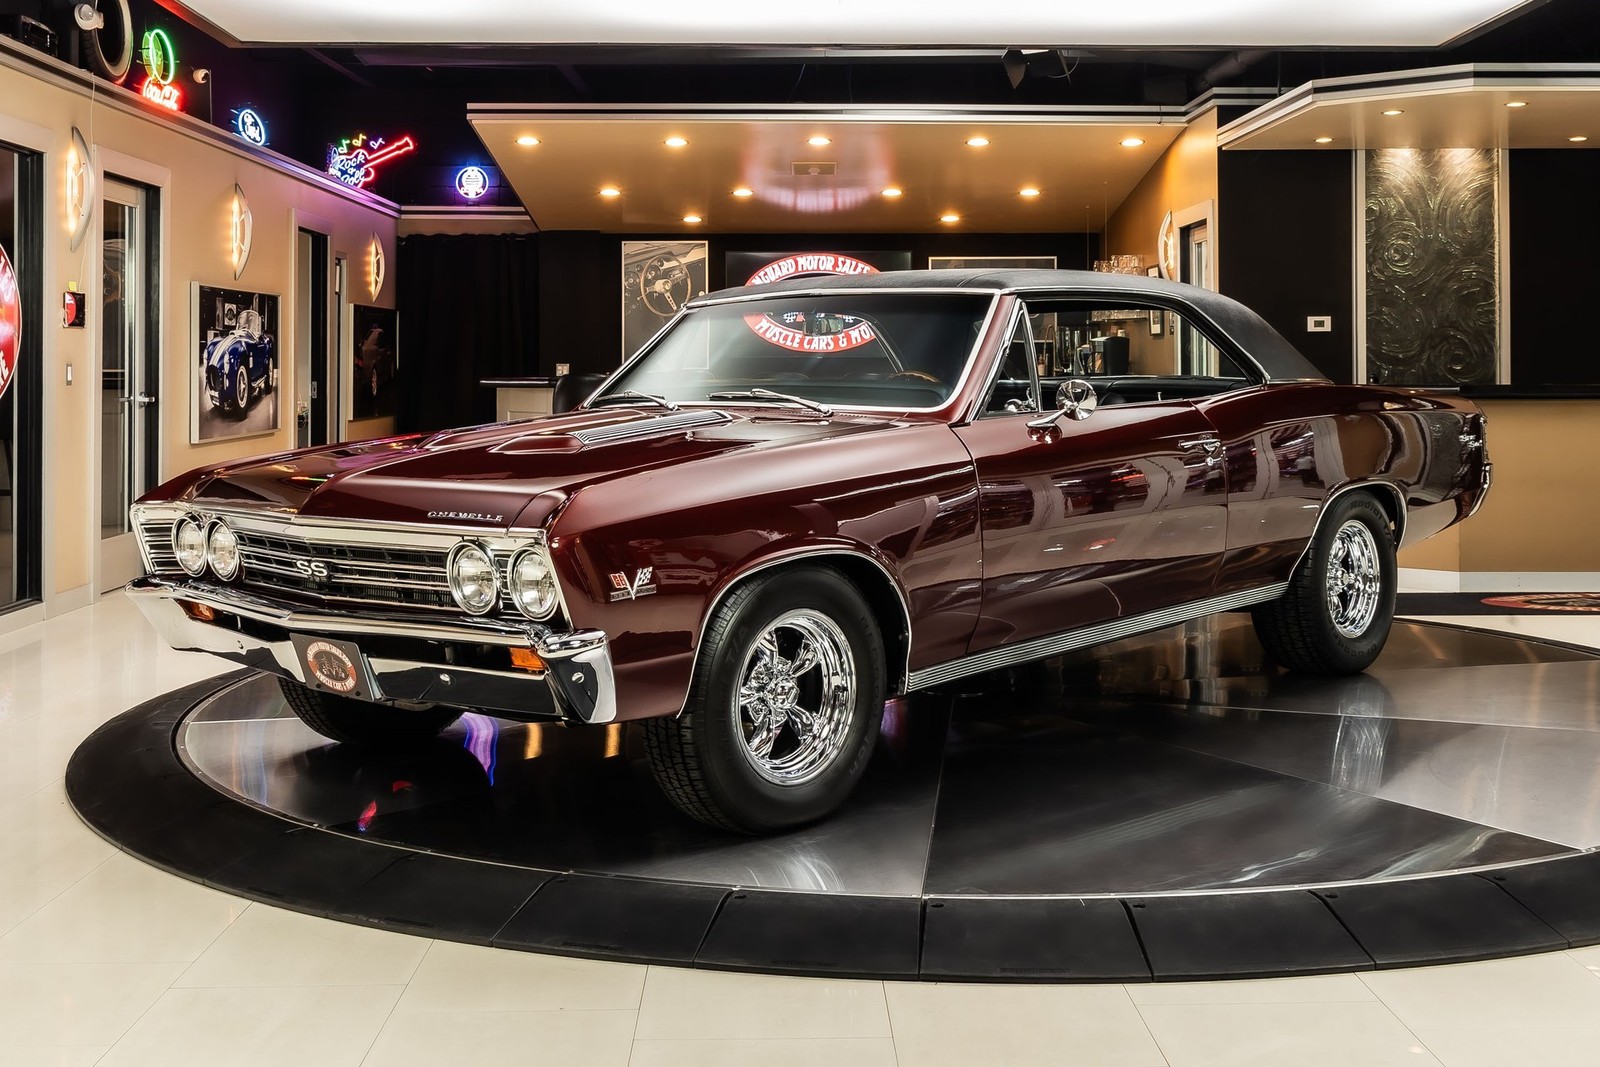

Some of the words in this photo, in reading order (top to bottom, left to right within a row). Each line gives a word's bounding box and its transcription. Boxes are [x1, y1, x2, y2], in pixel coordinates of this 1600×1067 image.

[338, 151, 366, 170] Rock
[796, 255, 835, 271] MOTOR
[754, 318, 802, 348] MUSCLE
[803, 335, 835, 350] CARS
[838, 333, 848, 348] &
[427, 511, 504, 522] CHEVELLE
[296, 560, 328, 577] SS
